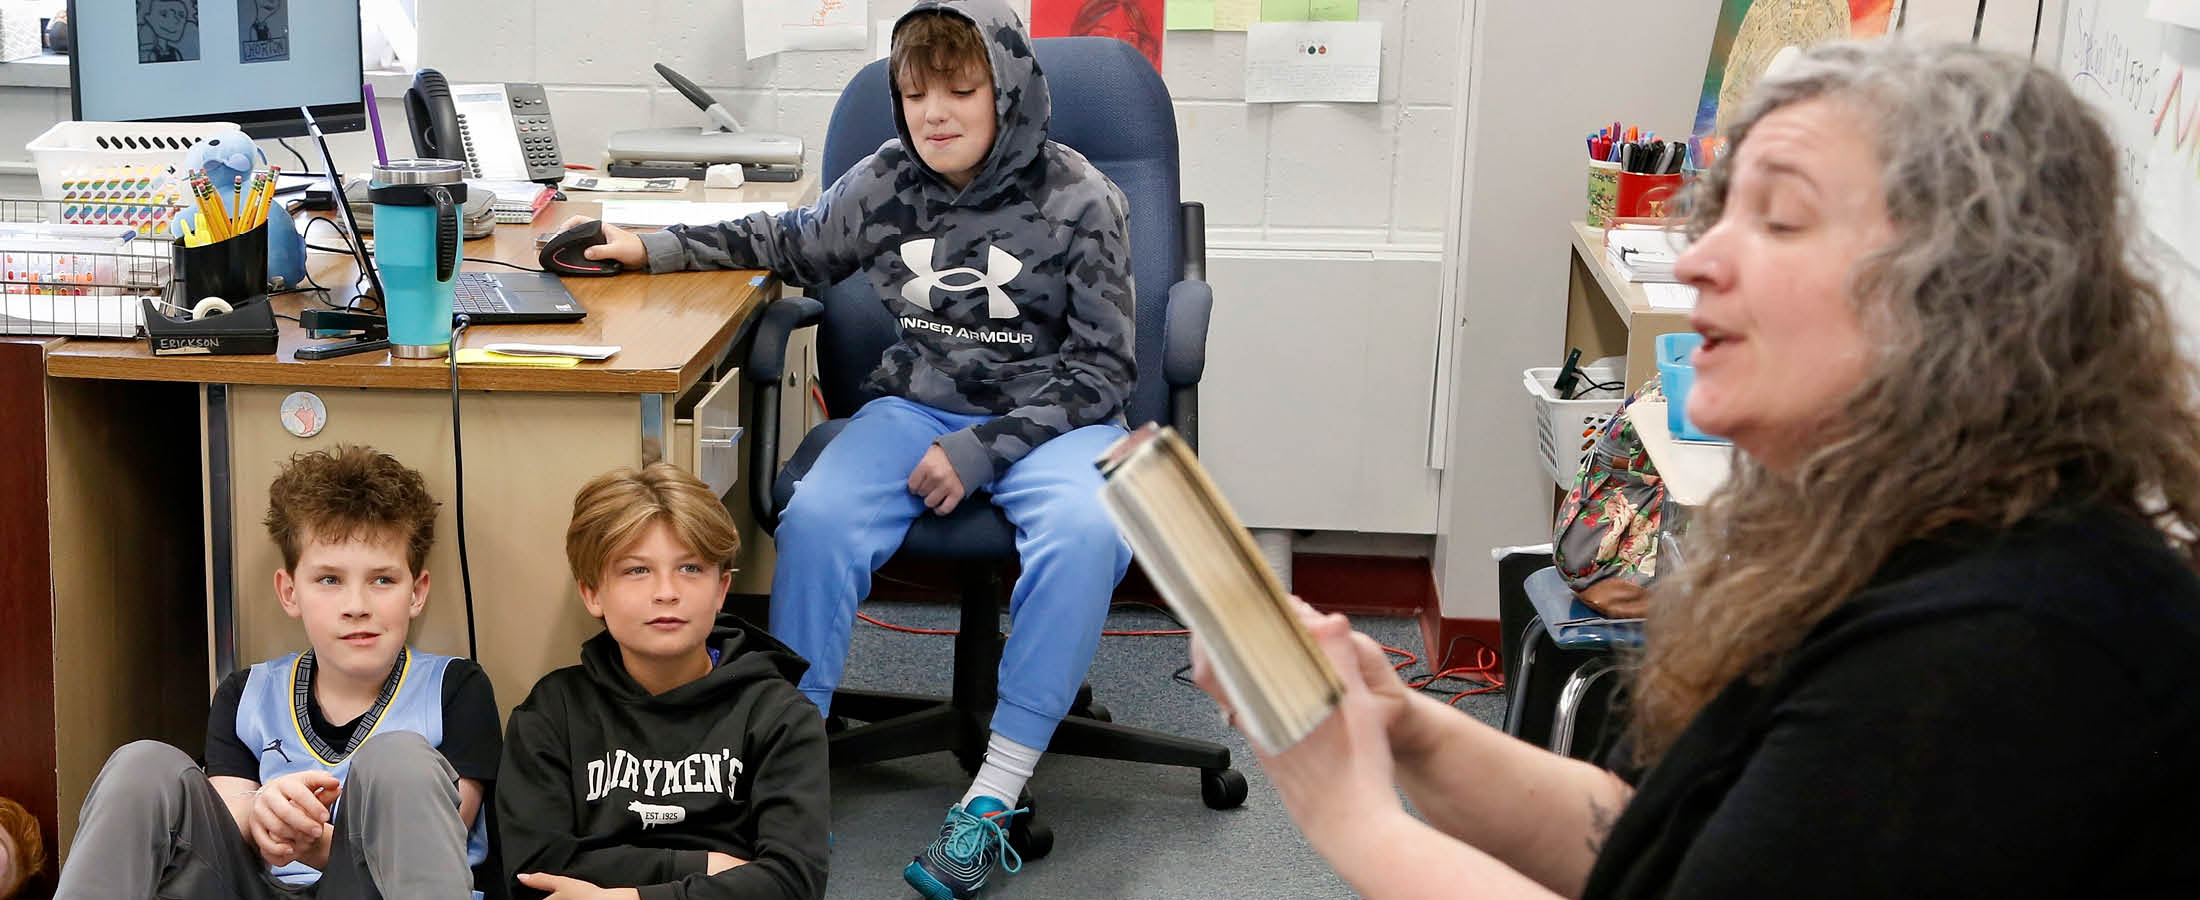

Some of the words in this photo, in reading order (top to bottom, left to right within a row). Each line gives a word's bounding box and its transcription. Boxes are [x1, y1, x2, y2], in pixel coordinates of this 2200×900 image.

[956, 327, 1034, 344] ARMOUR
[160, 338, 220, 349] ERICKSON
[662, 812, 678, 820] 1925
